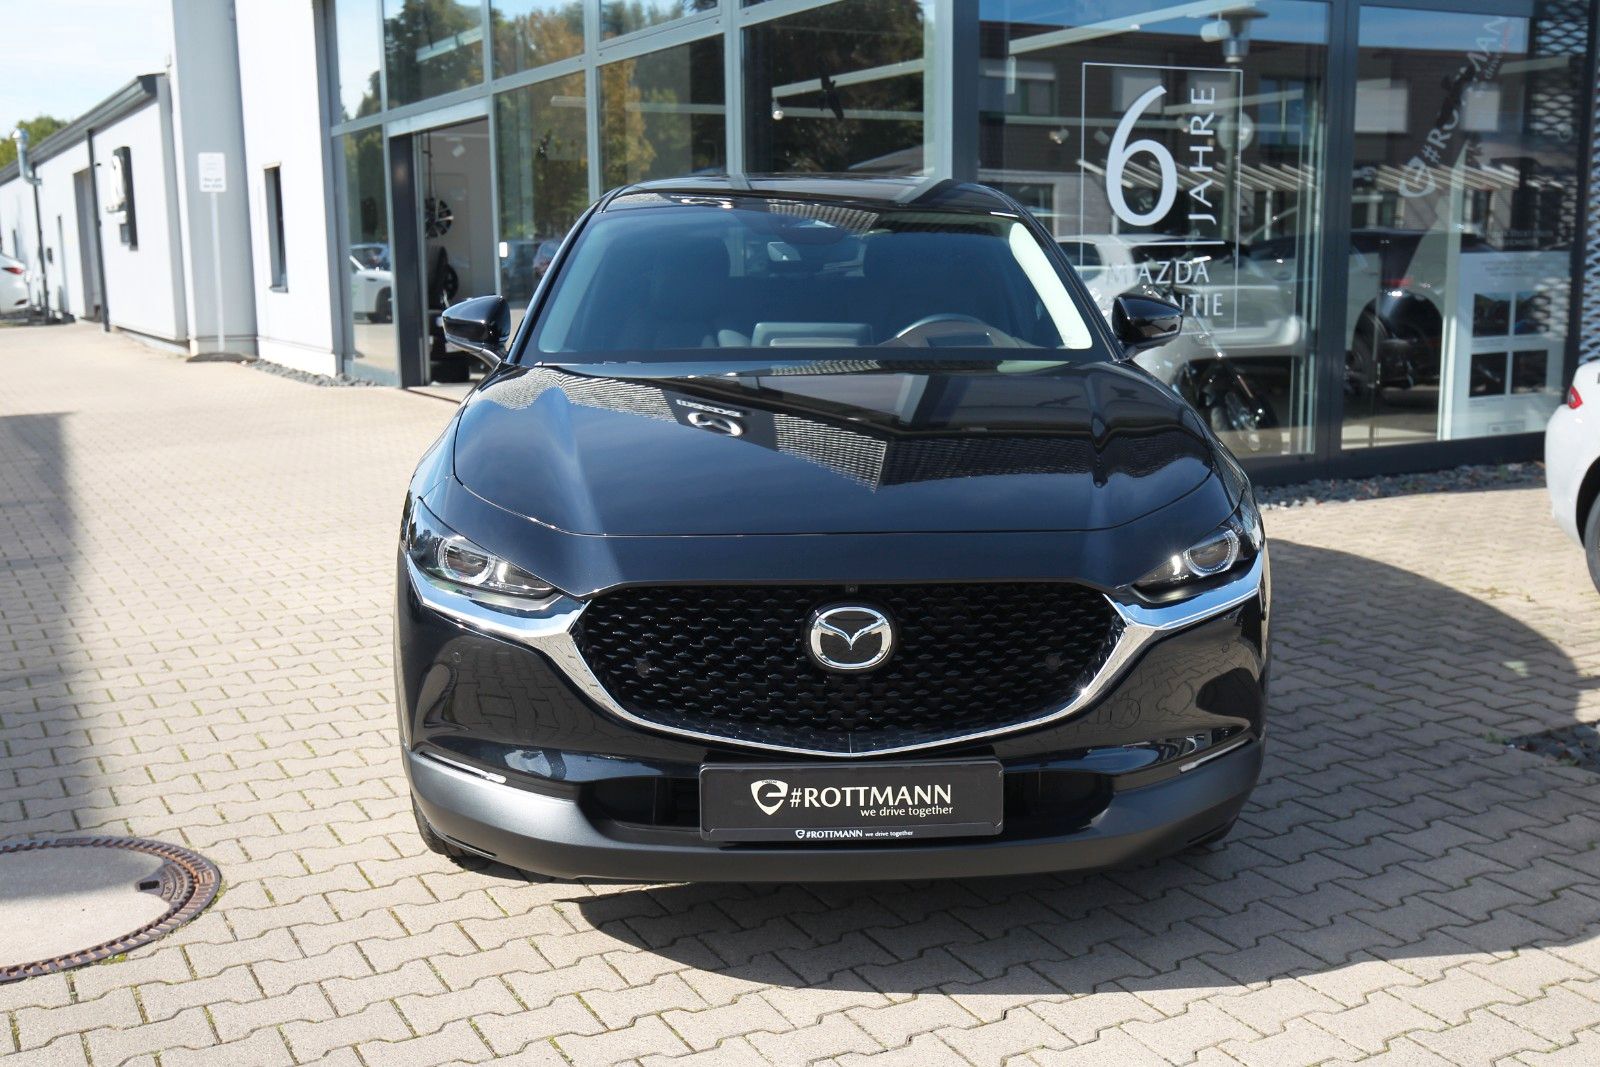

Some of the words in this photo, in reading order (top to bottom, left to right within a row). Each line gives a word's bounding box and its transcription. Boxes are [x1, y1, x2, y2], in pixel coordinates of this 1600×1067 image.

[1106, 84, 1178, 226] 6
[1188, 87, 1217, 225] JAHRE
[789, 784, 952, 808] #ROTTMANN
[860, 808, 876, 817] we
[879, 806, 905, 816] drive
[908, 805, 953, 818] together
